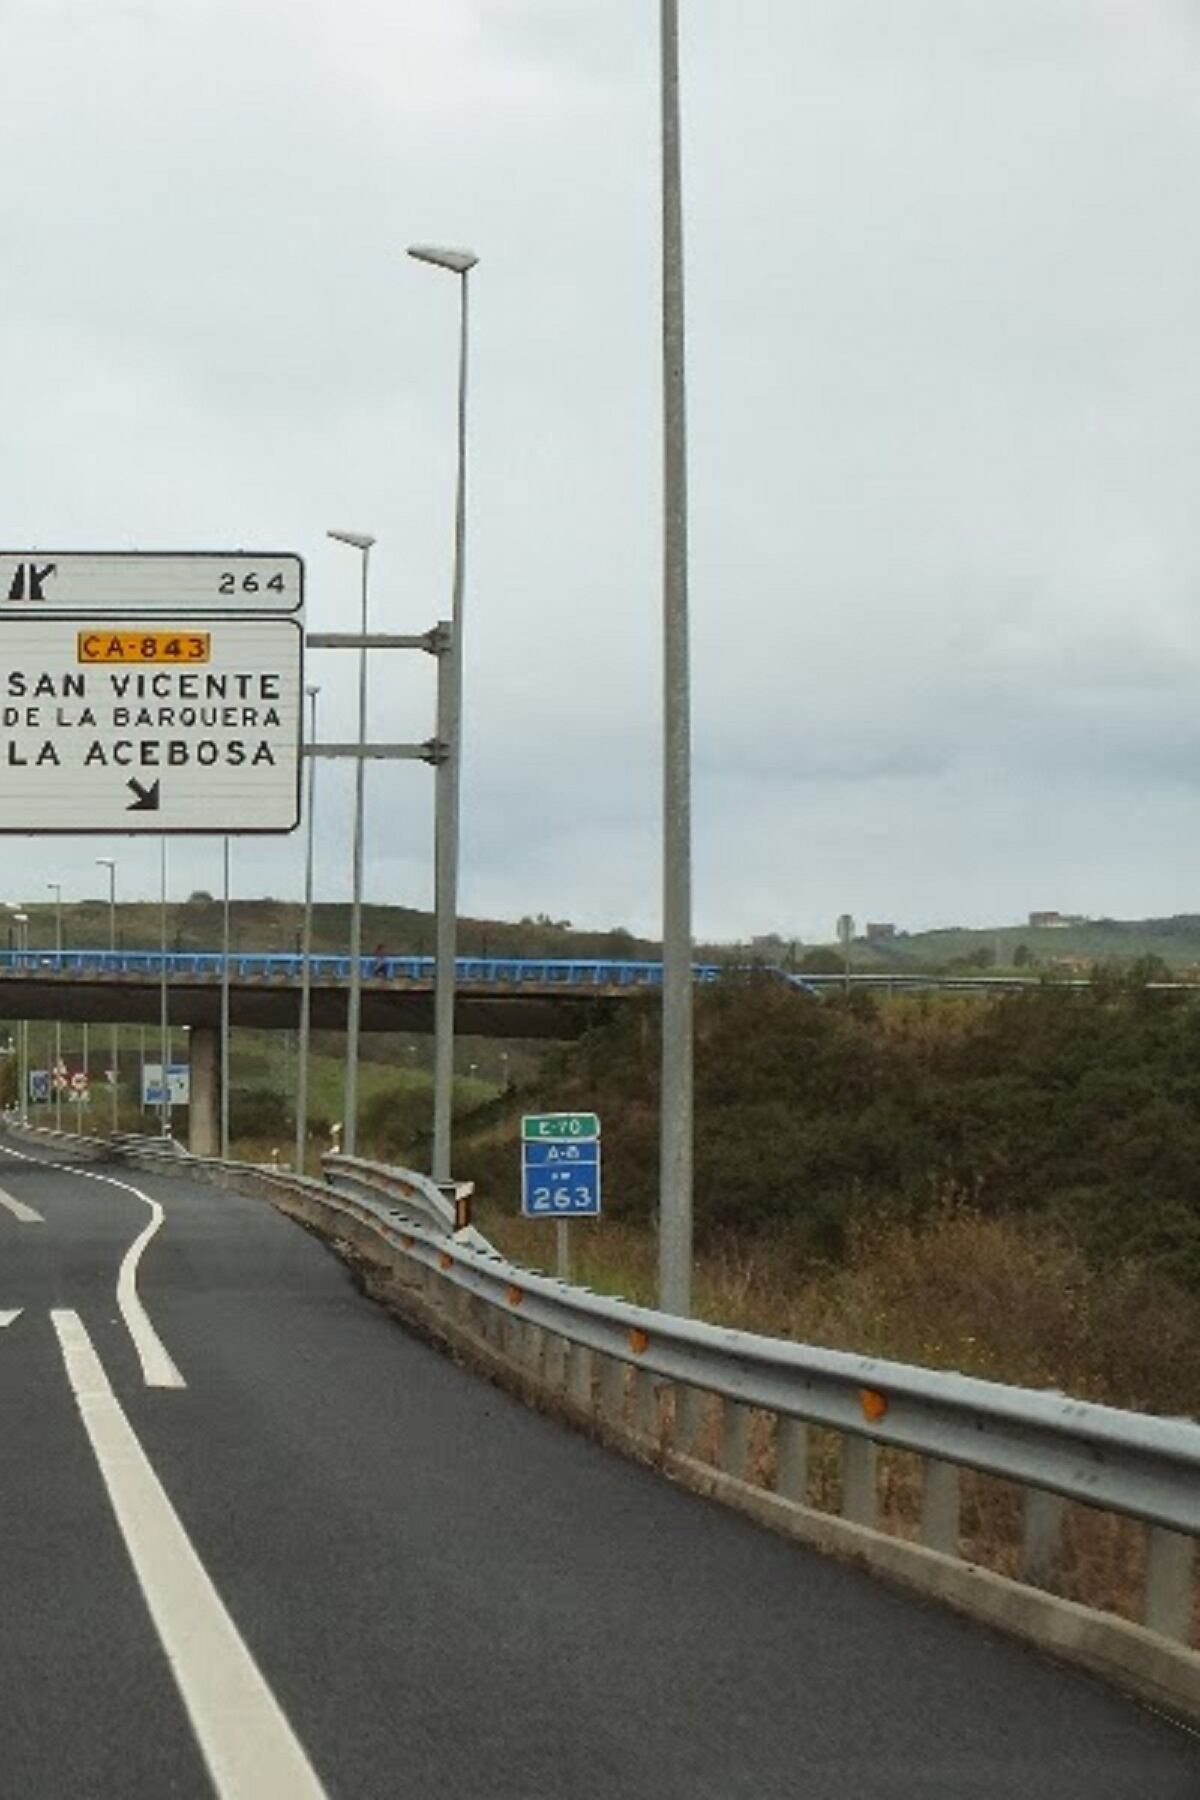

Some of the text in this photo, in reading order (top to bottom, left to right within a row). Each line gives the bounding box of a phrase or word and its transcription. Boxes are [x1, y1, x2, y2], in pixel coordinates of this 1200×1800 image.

[219, 573, 285, 595] 264
[84, 636, 206, 658] CA-843
[7, 672, 280, 699] SAN VICENTE
[3, 707, 281, 727] DE LA BARQUERA
[8, 741, 276, 766] LA ACEBOSA
[533, 1186, 592, 1210] 263
